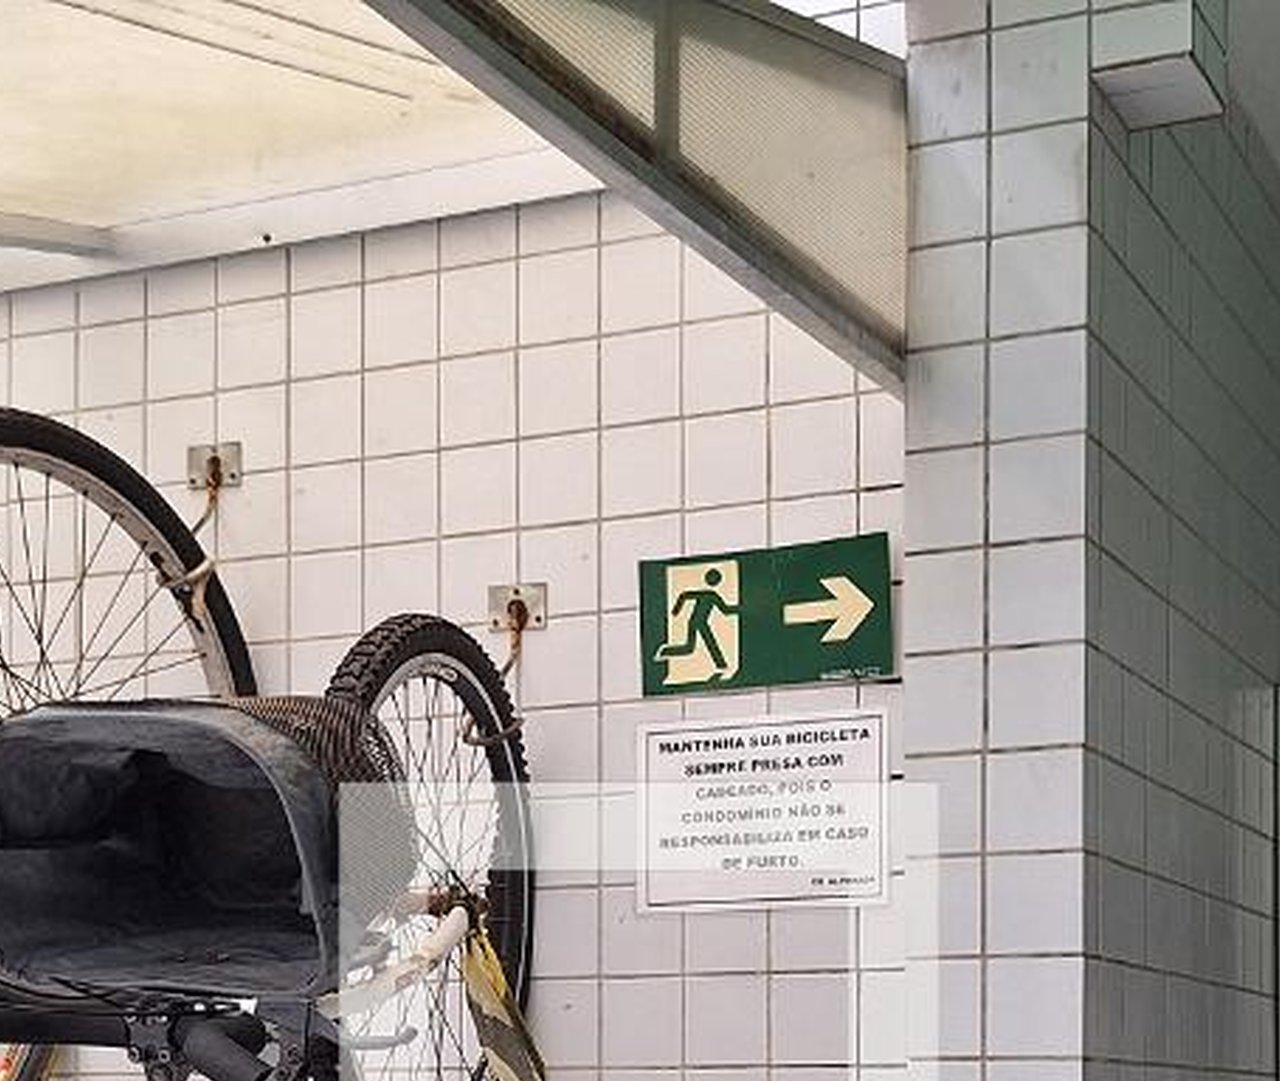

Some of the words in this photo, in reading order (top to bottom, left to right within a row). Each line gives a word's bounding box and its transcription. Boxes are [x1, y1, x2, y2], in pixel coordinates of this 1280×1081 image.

[658, 738, 746, 755] MANTENHA
[748, 734, 782, 749] SUA
[785, 728, 870, 746] BICICLETA
[684, 761, 747, 777] SEMPRE
[751, 757, 802, 773] PRESA
[807, 754, 844, 768] COM
[778, 779, 815, 796] POIS
[819, 779, 832, 792] O
[788, 803, 821, 819] NÃO
[797, 829, 821, 843] EM
[825, 826, 869, 840] CASO
